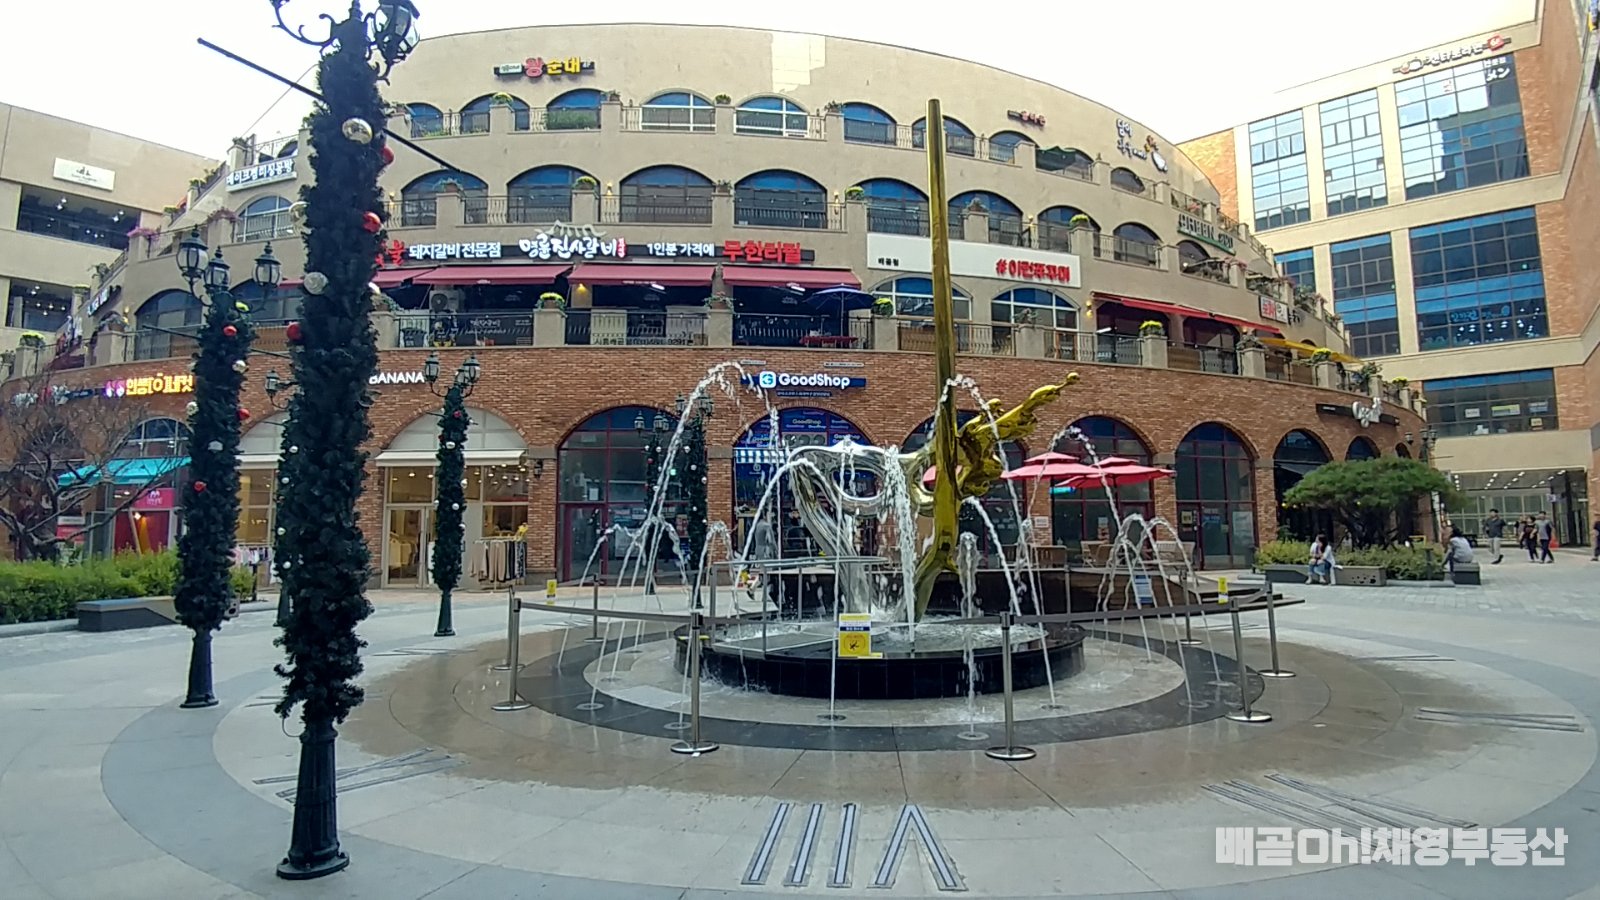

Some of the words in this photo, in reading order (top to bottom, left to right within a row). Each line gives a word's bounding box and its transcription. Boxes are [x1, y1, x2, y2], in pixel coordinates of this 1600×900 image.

[524, 56, 581, 78] 왕순대
[409, 242, 461, 260] 돼지갈비
[462, 241, 501, 259] 전문점
[646, 243, 680, 257] 1인분
[680, 243, 715, 257] 가격에
[722, 240, 801, 264] 무한리필
[778, 373, 851, 390] GoodShop
